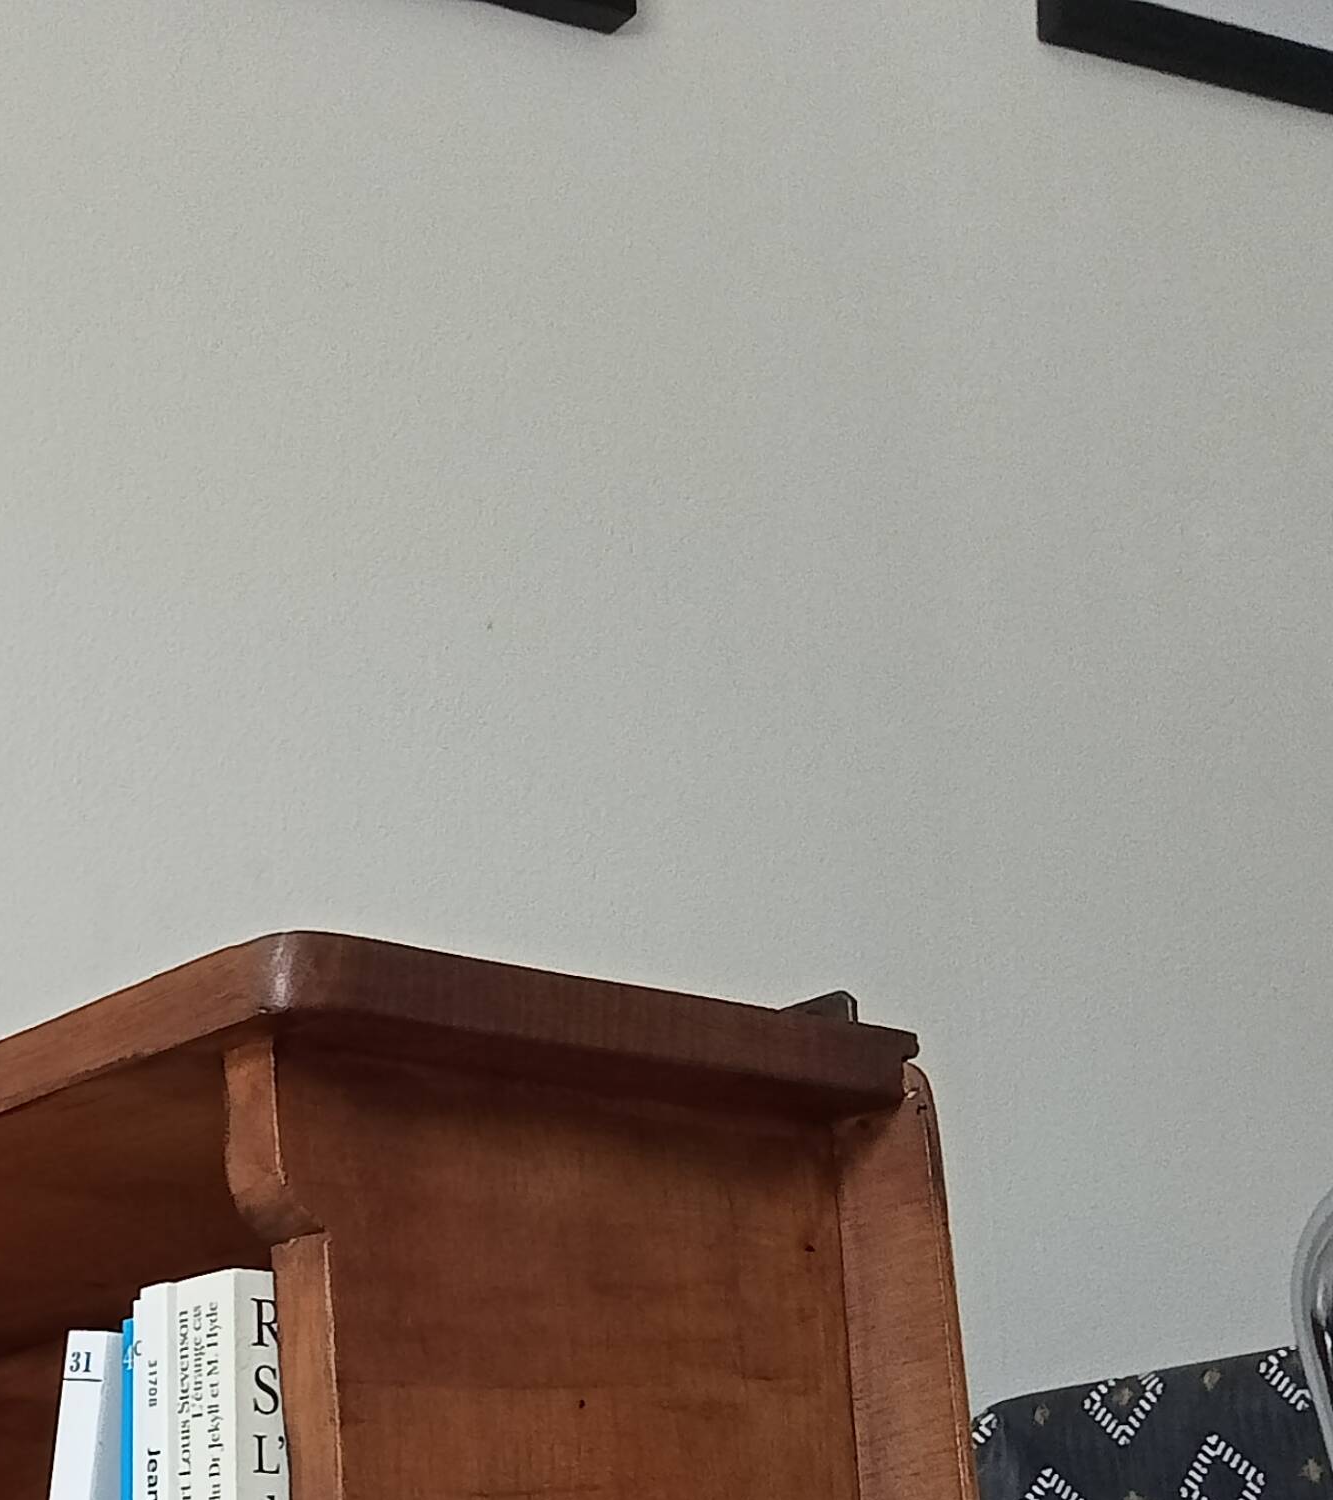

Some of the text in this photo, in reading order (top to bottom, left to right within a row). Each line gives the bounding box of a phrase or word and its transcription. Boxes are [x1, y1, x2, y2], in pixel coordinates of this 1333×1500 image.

[193, 1305, 203, 1331] cas
[206, 1301, 222, 1347] Hyde
[69, 1351, 92, 1373] 31
[177, 1310, 191, 1414] Stevenson
[178, 1419, 191, 1476] Louis
[207, 1404, 224, 1451] Jekyll
